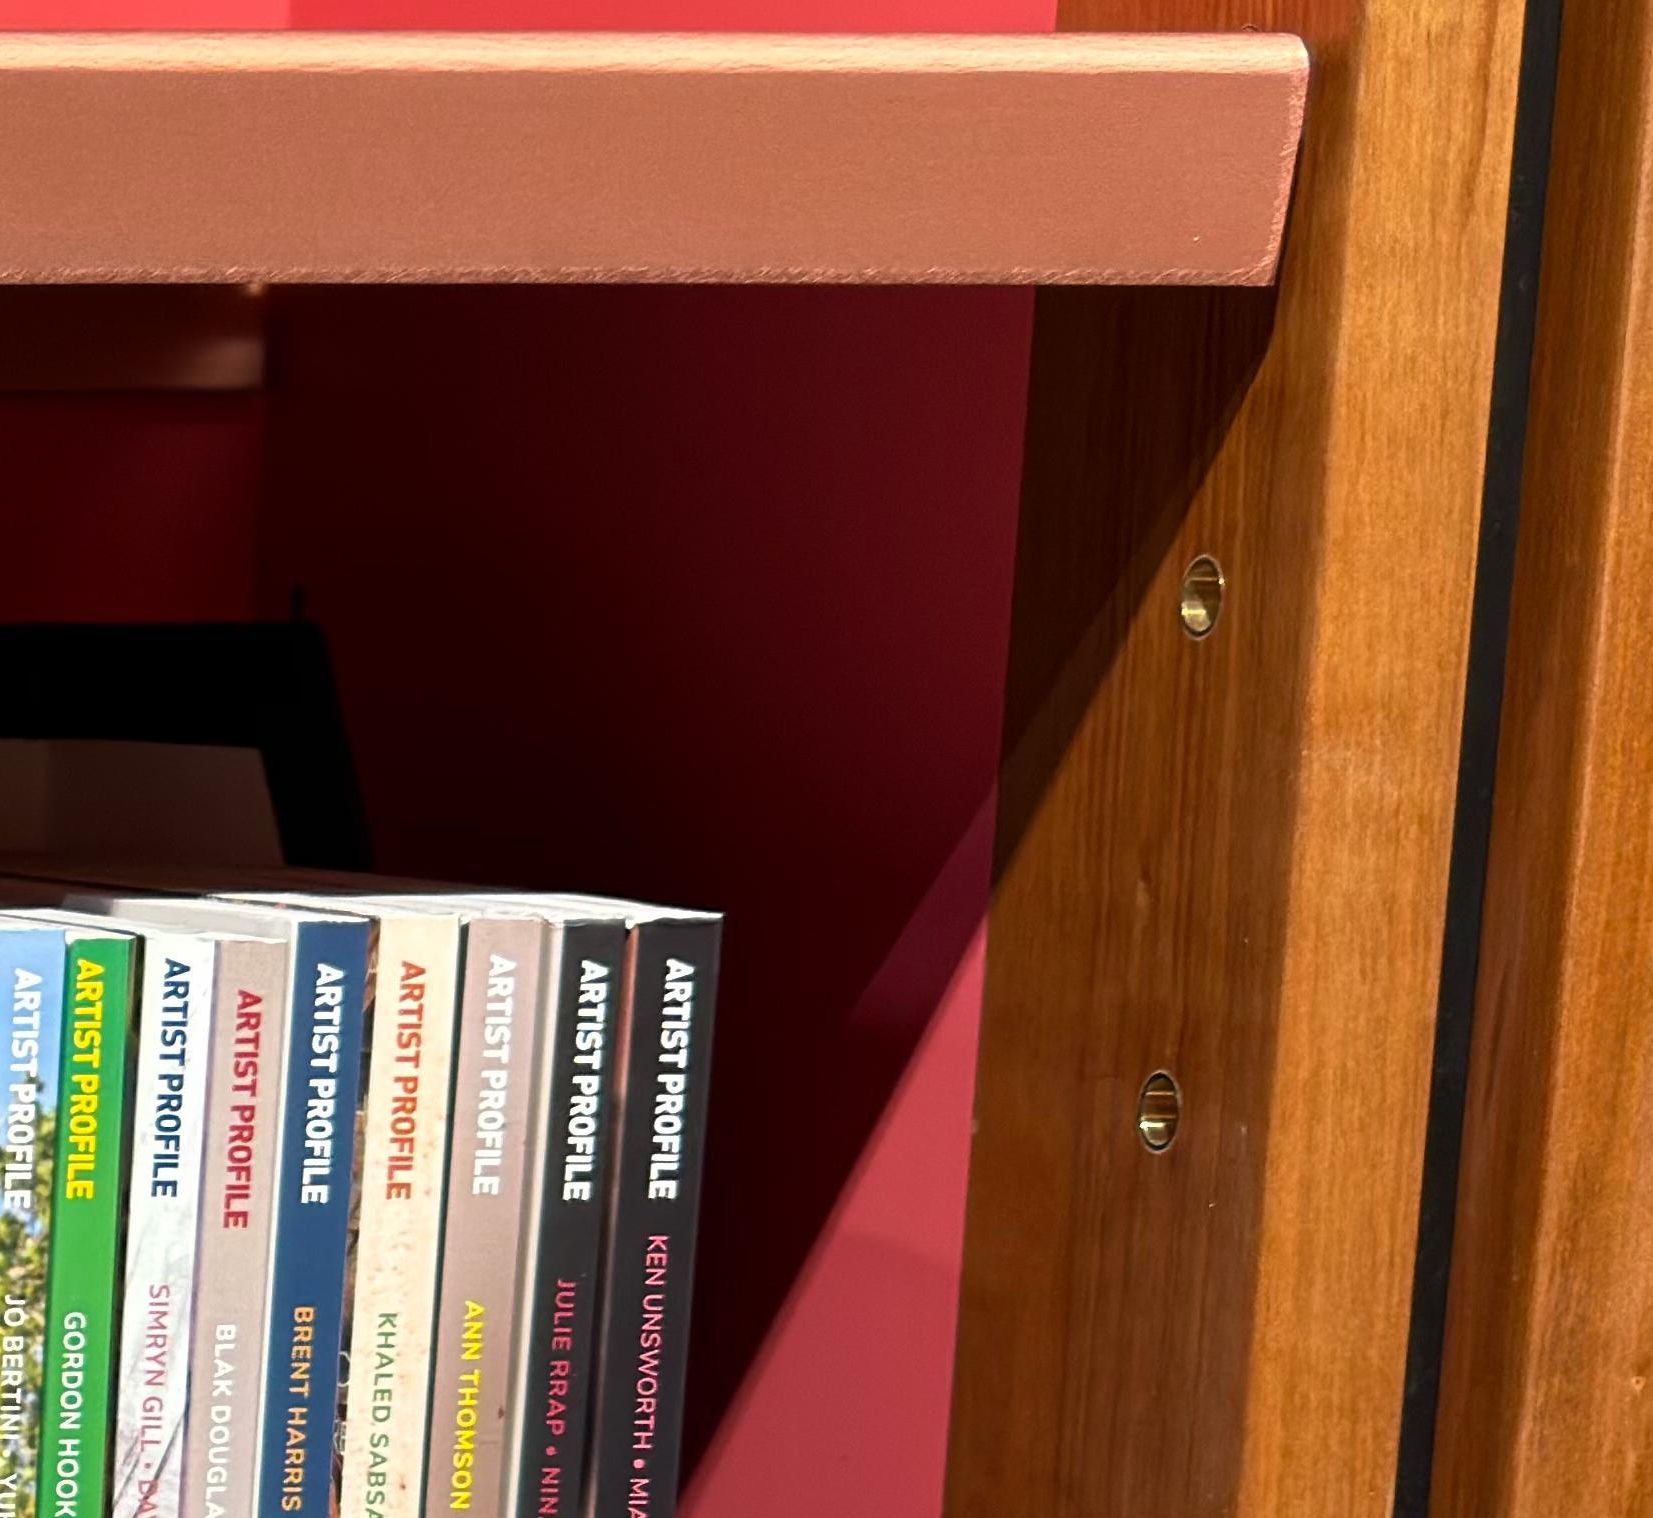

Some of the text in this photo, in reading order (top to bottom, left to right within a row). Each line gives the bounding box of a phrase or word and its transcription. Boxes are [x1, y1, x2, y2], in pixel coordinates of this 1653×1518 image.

[633, 959, 694, 1448] ARTIST PROFILE KEN UNSWORTH
[372, 1313, 398, 1422] KHALED
[450, 1301, 484, 1508] ANN THOMSON
[546, 1279, 576, 1435] JULIE RRAP
